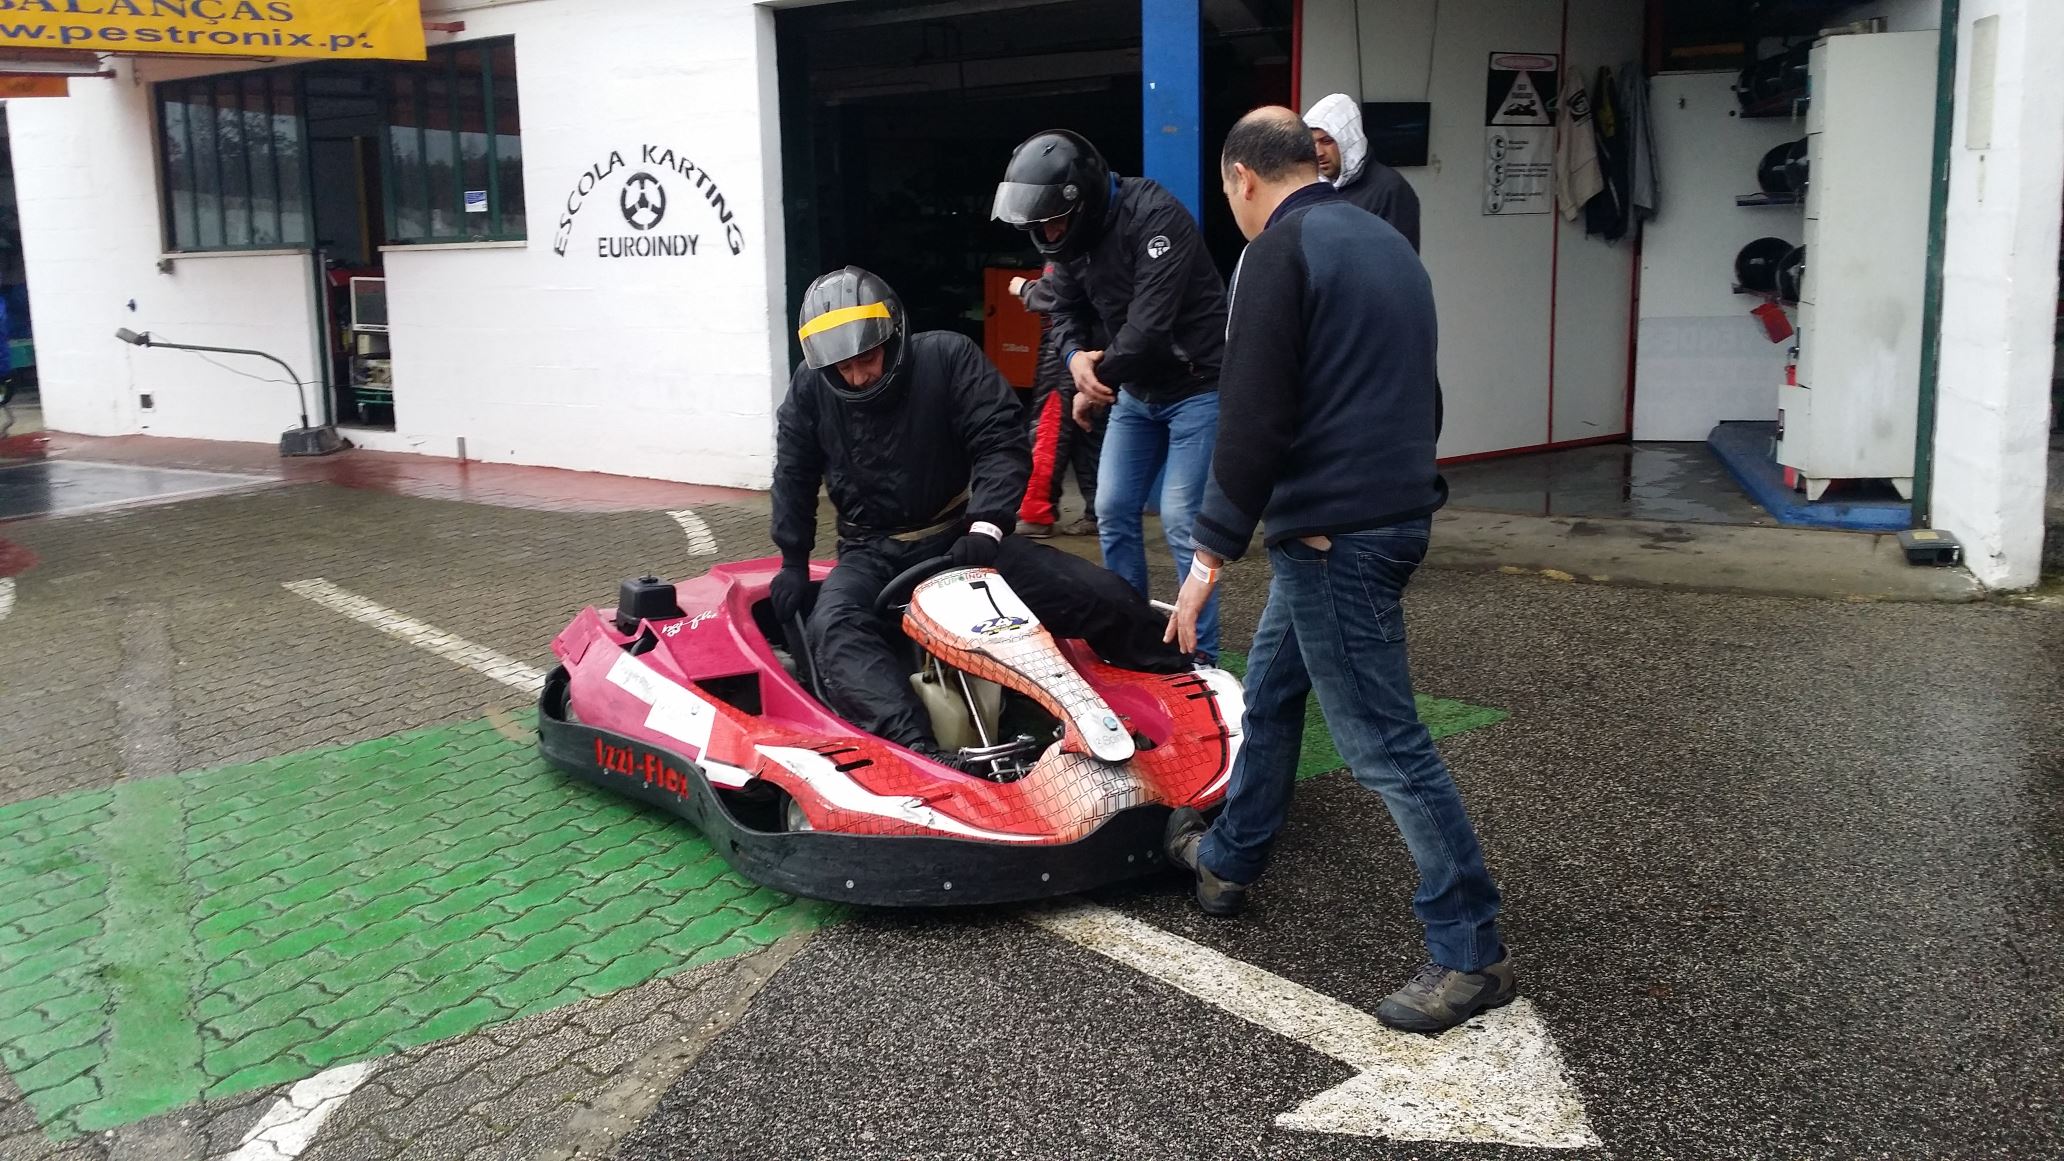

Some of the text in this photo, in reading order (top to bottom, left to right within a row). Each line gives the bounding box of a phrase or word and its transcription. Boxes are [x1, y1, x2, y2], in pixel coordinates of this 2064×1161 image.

[0, 0, 294, 25] ALANÇAS
[554, 144, 745, 257] ESCOLA KARTING
[598, 234, 699, 258] EUROINDY
[969, 580, 1006, 619] 7
